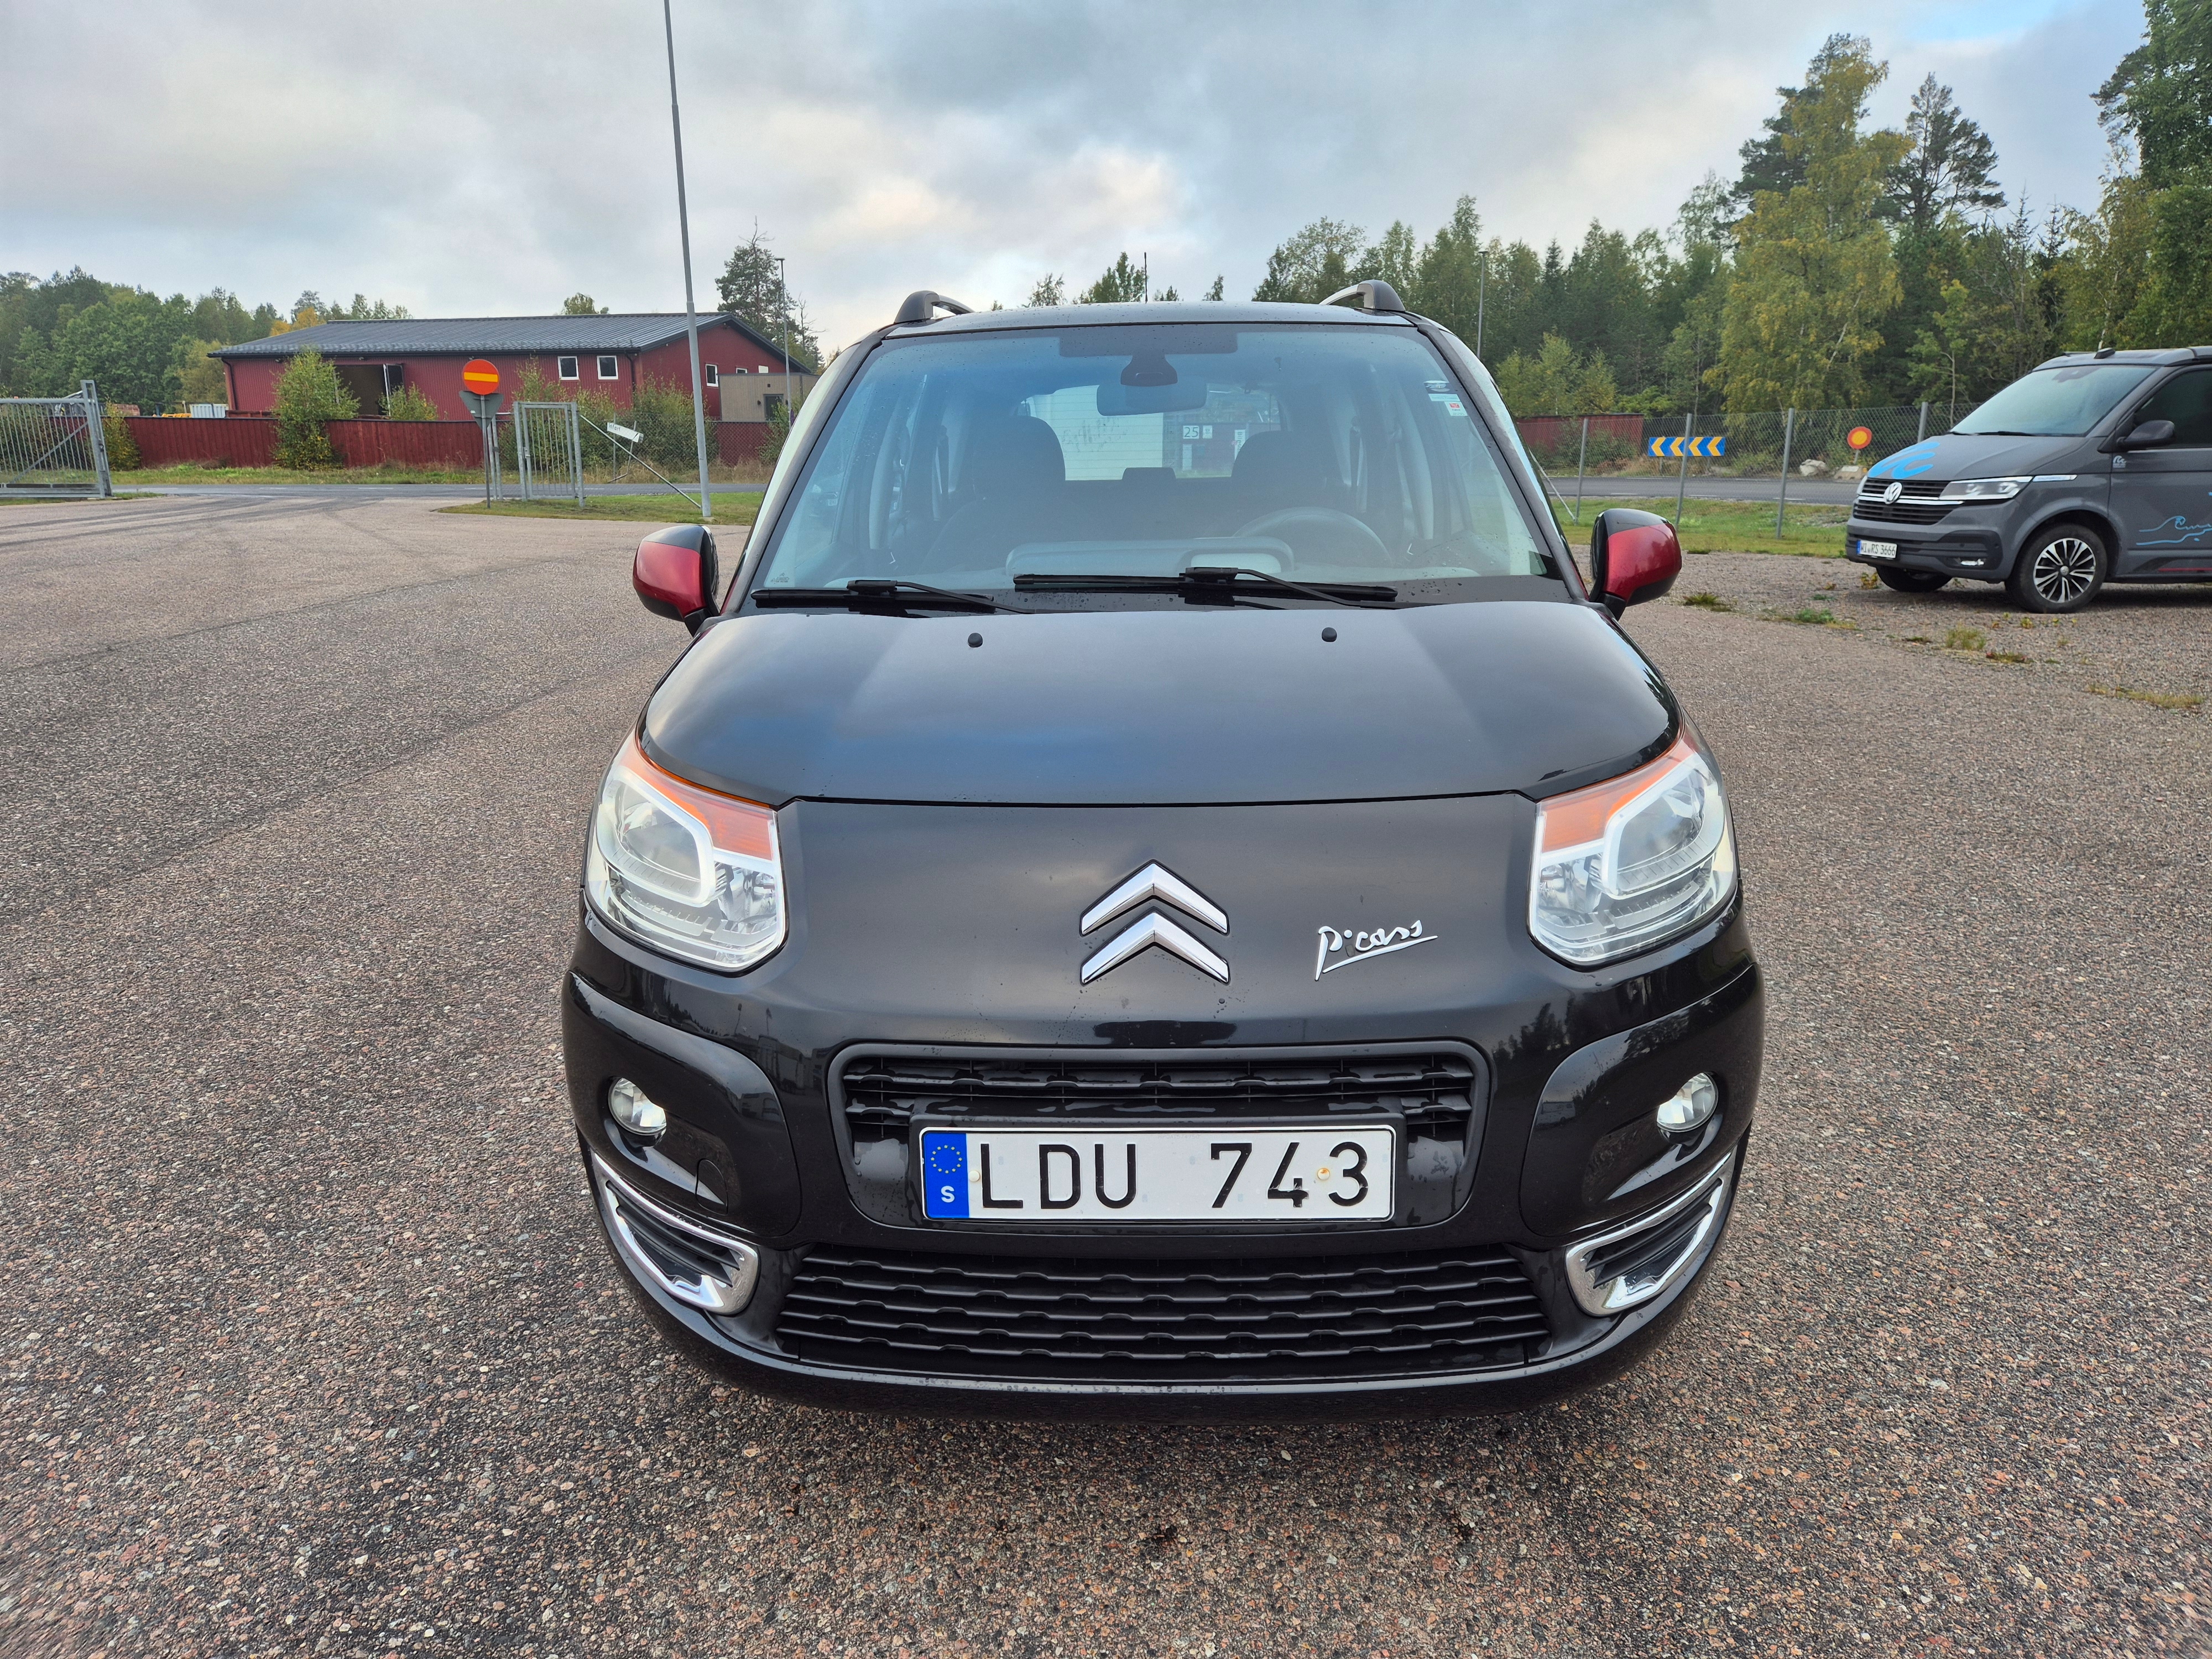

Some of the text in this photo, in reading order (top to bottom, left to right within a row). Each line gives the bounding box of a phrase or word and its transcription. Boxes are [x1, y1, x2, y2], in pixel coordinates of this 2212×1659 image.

[1184, 426, 1198, 437] 25
[980, 1141, 1369, 1209] LDU 743
[941, 1185, 955, 1203] S
